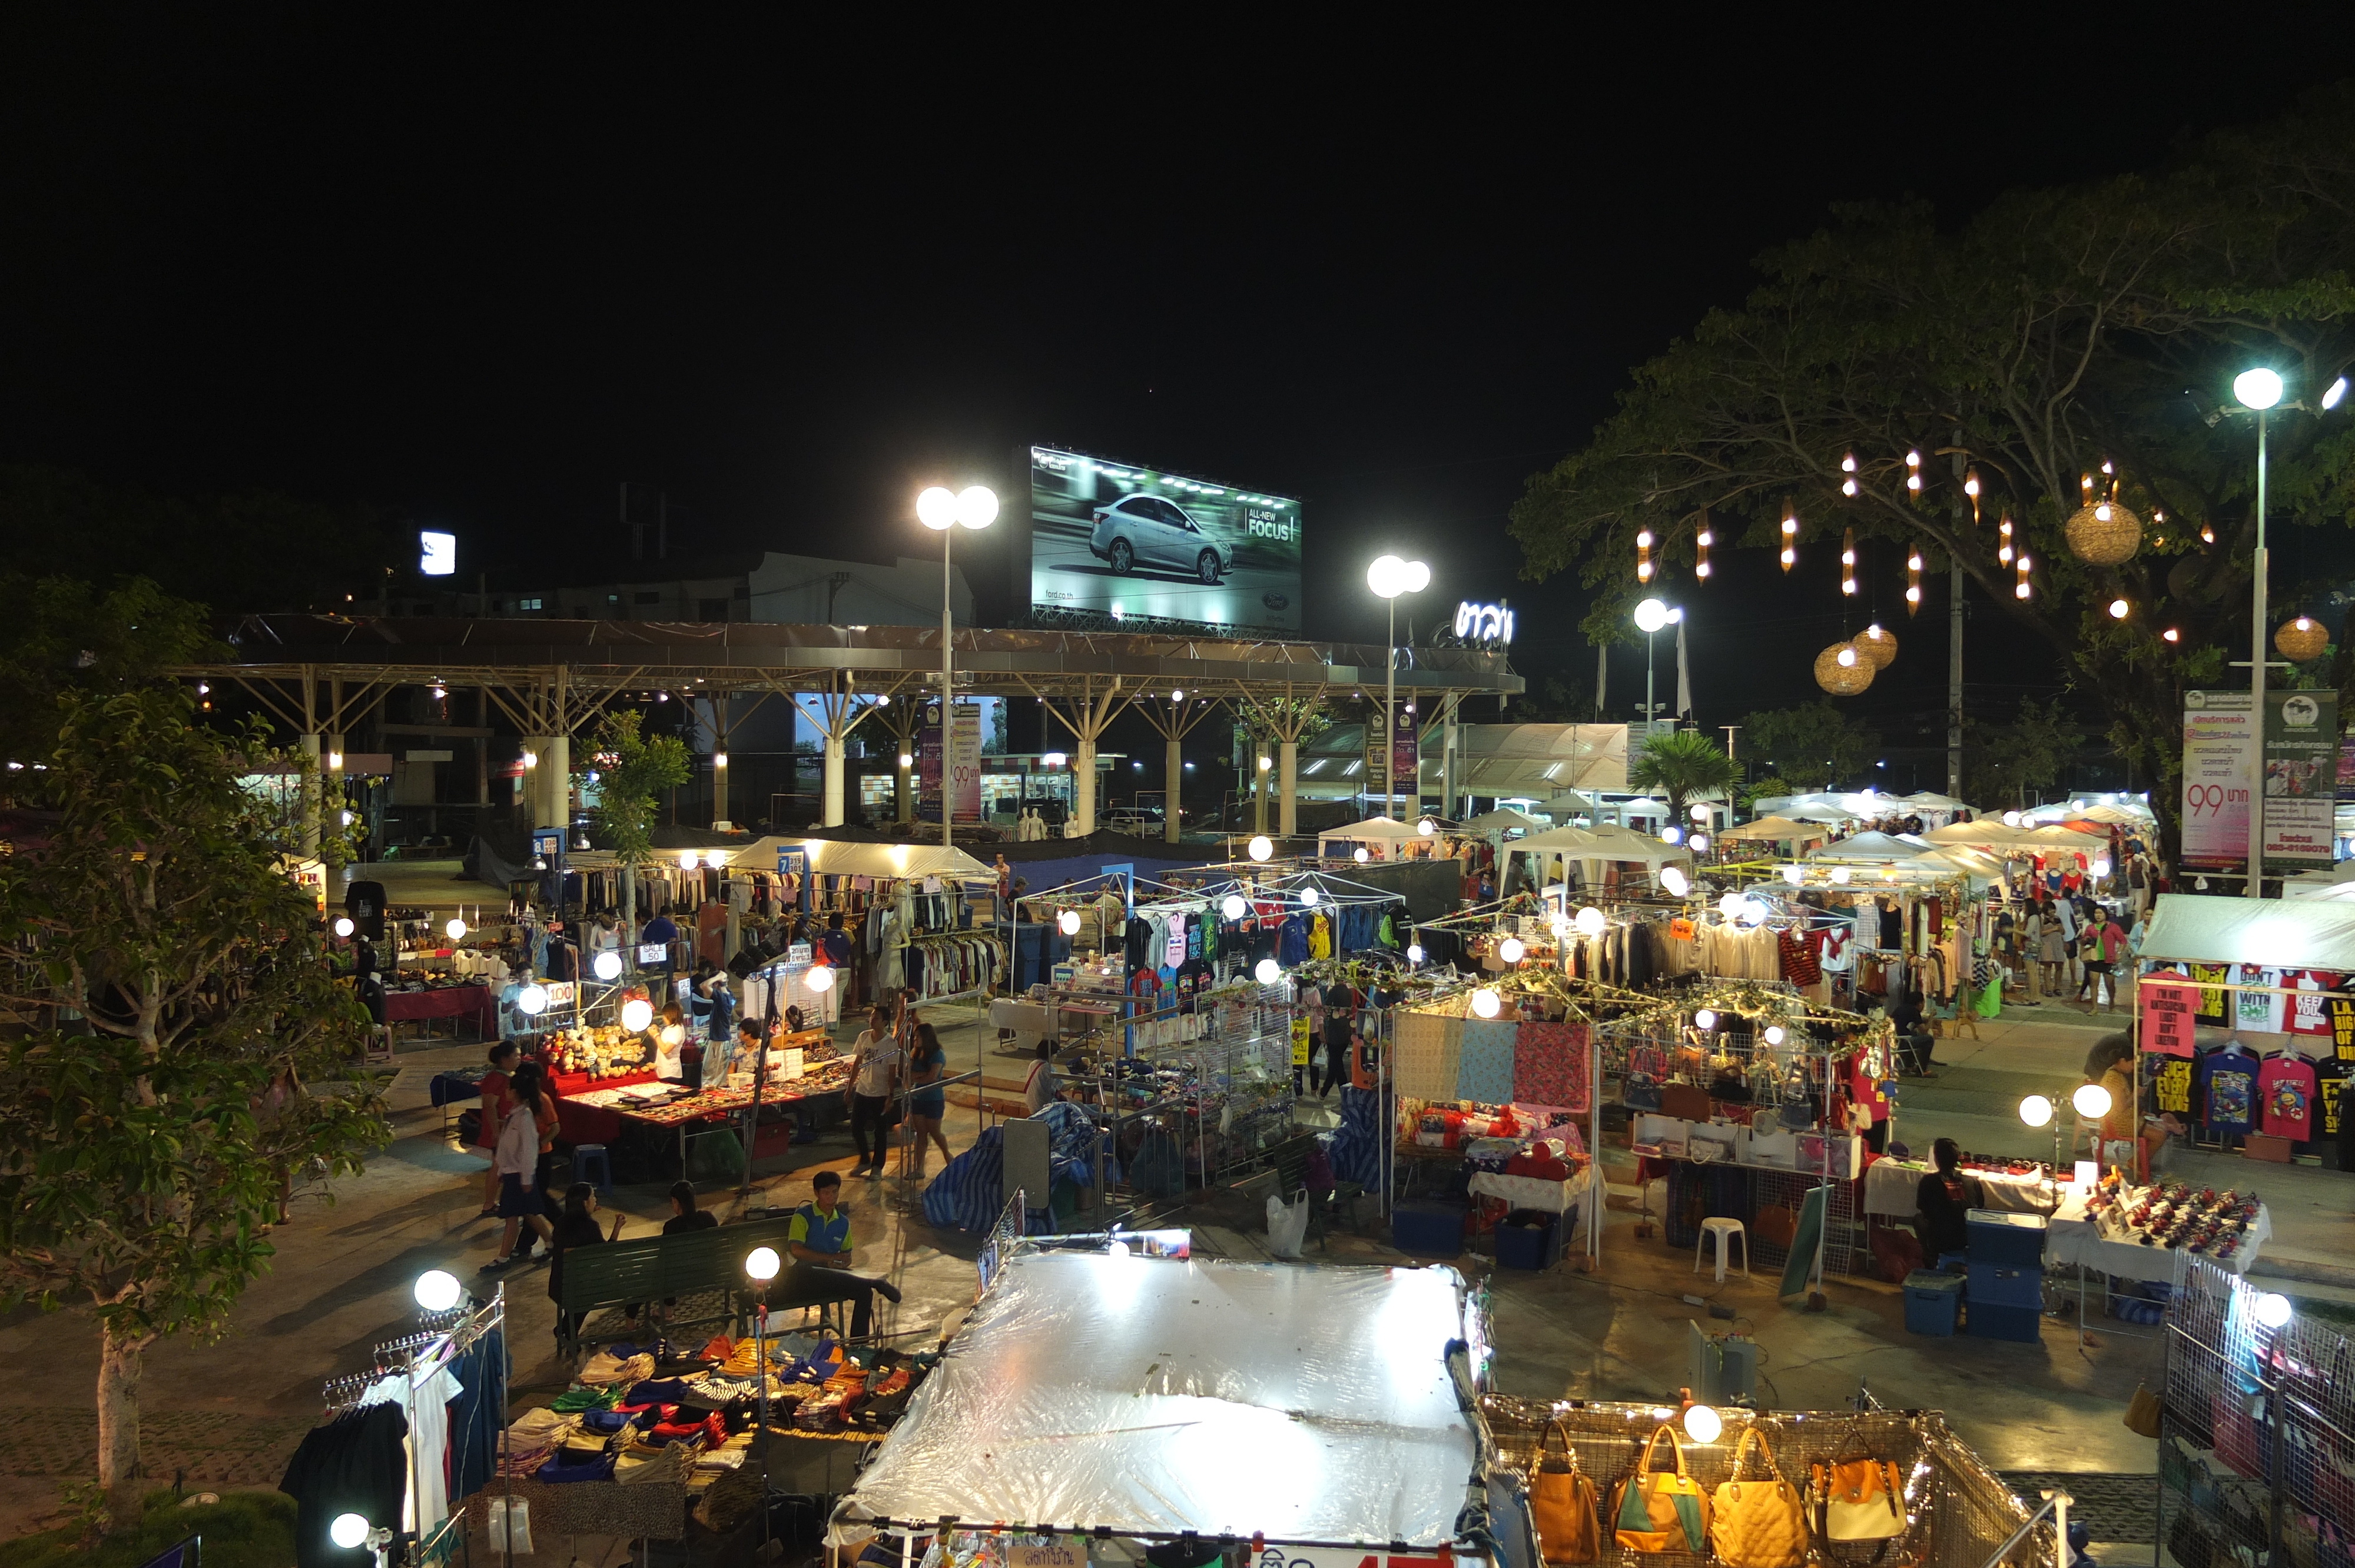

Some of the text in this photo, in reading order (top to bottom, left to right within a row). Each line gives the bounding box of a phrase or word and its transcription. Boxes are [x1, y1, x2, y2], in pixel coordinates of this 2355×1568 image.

[1249, 509, 1276, 521] ALL-NEW
[1249, 519, 1289, 541] FOCUS
[1046, 589, 1073, 599] ford.co.th
[954, 766, 969, 788] 99
[2188, 783, 2248, 817] 99 บาท
[535, 842, 541, 853] 8
[781, 859, 787, 872] 7
[648, 952, 659, 961] 50
[550, 986, 573, 1001] 100
[2240, 992, 2271, 1006] WITH
[2336, 1031, 2352, 1045] OF
